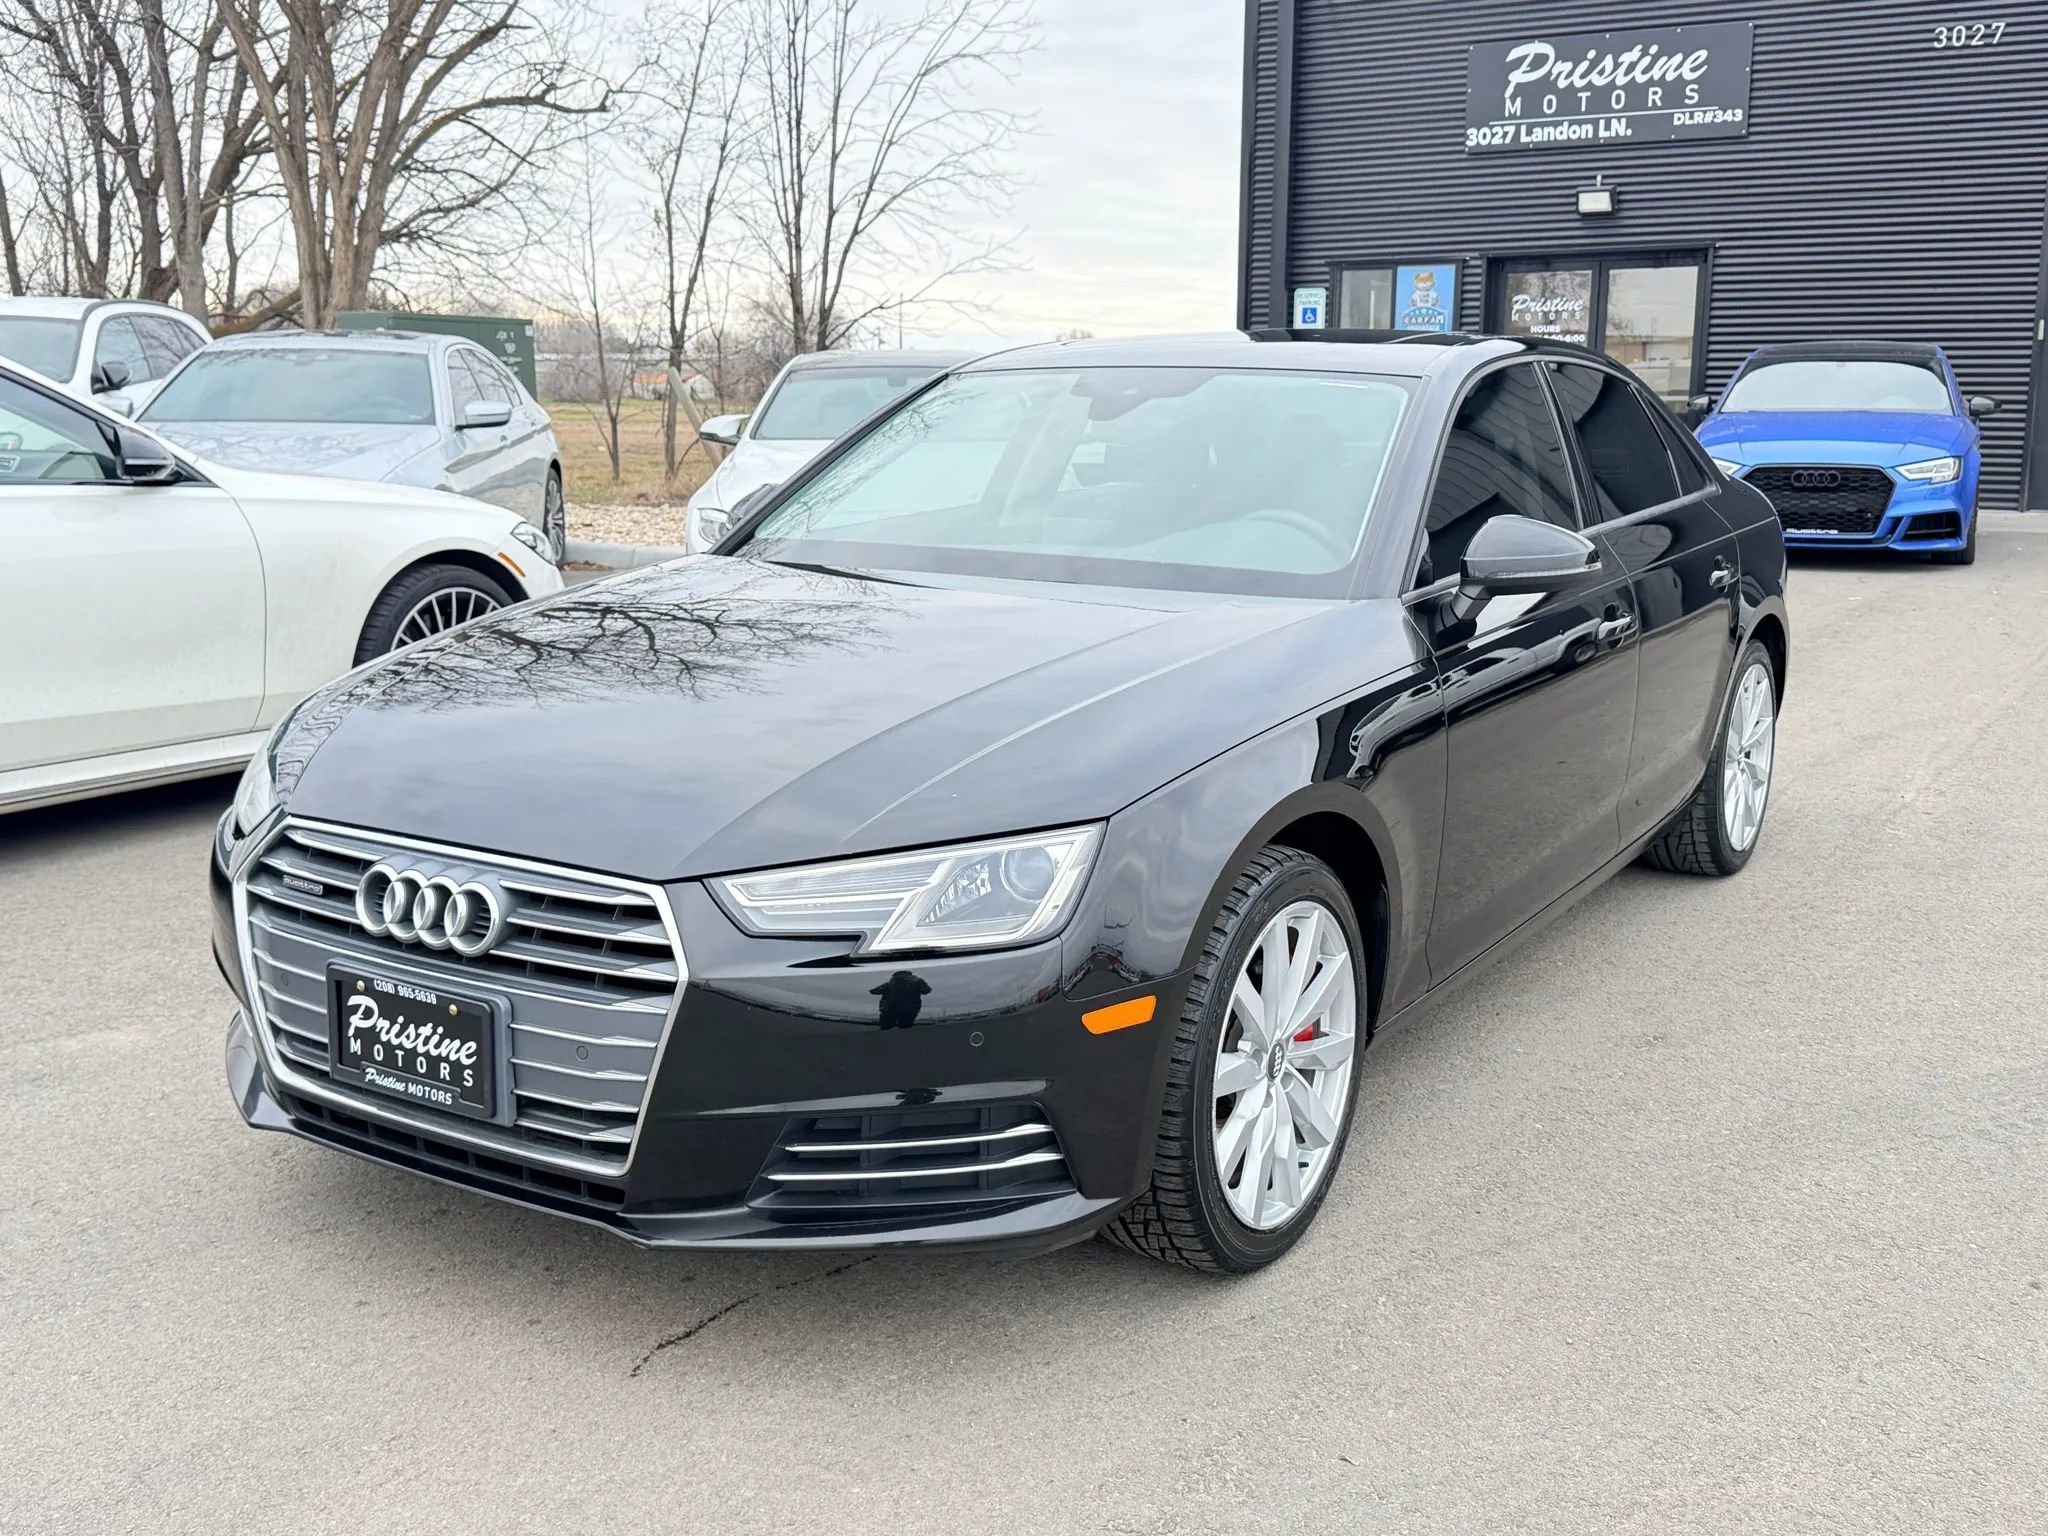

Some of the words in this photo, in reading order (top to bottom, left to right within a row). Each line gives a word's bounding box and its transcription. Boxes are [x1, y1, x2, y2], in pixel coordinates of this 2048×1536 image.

[1933, 21, 2006, 48] 3027
[1504, 42, 1708, 98] Pristine
[1504, 84, 1699, 118] MOTORS
[1673, 108, 1743, 126] DLR#343
[1465, 126, 1515, 147] 3027
[1520, 121, 1593, 143] Landon
[1598, 118, 1632, 138] LN.
[1512, 294, 1583, 314] Pristine
[1512, 311, 1581, 322] MOTORS
[1530, 325, 1561, 333] HOURS
[283, 877, 321, 893] quattro
[374, 979, 396, 995] (208)
[397, 985, 437, 1005] 965-5639
[347, 995, 478, 1066] Pristine
[350, 1036, 474, 1087] MOTORS
[364, 1067, 406, 1092] Pristine
[407, 1082, 453, 1105] MOTORS
